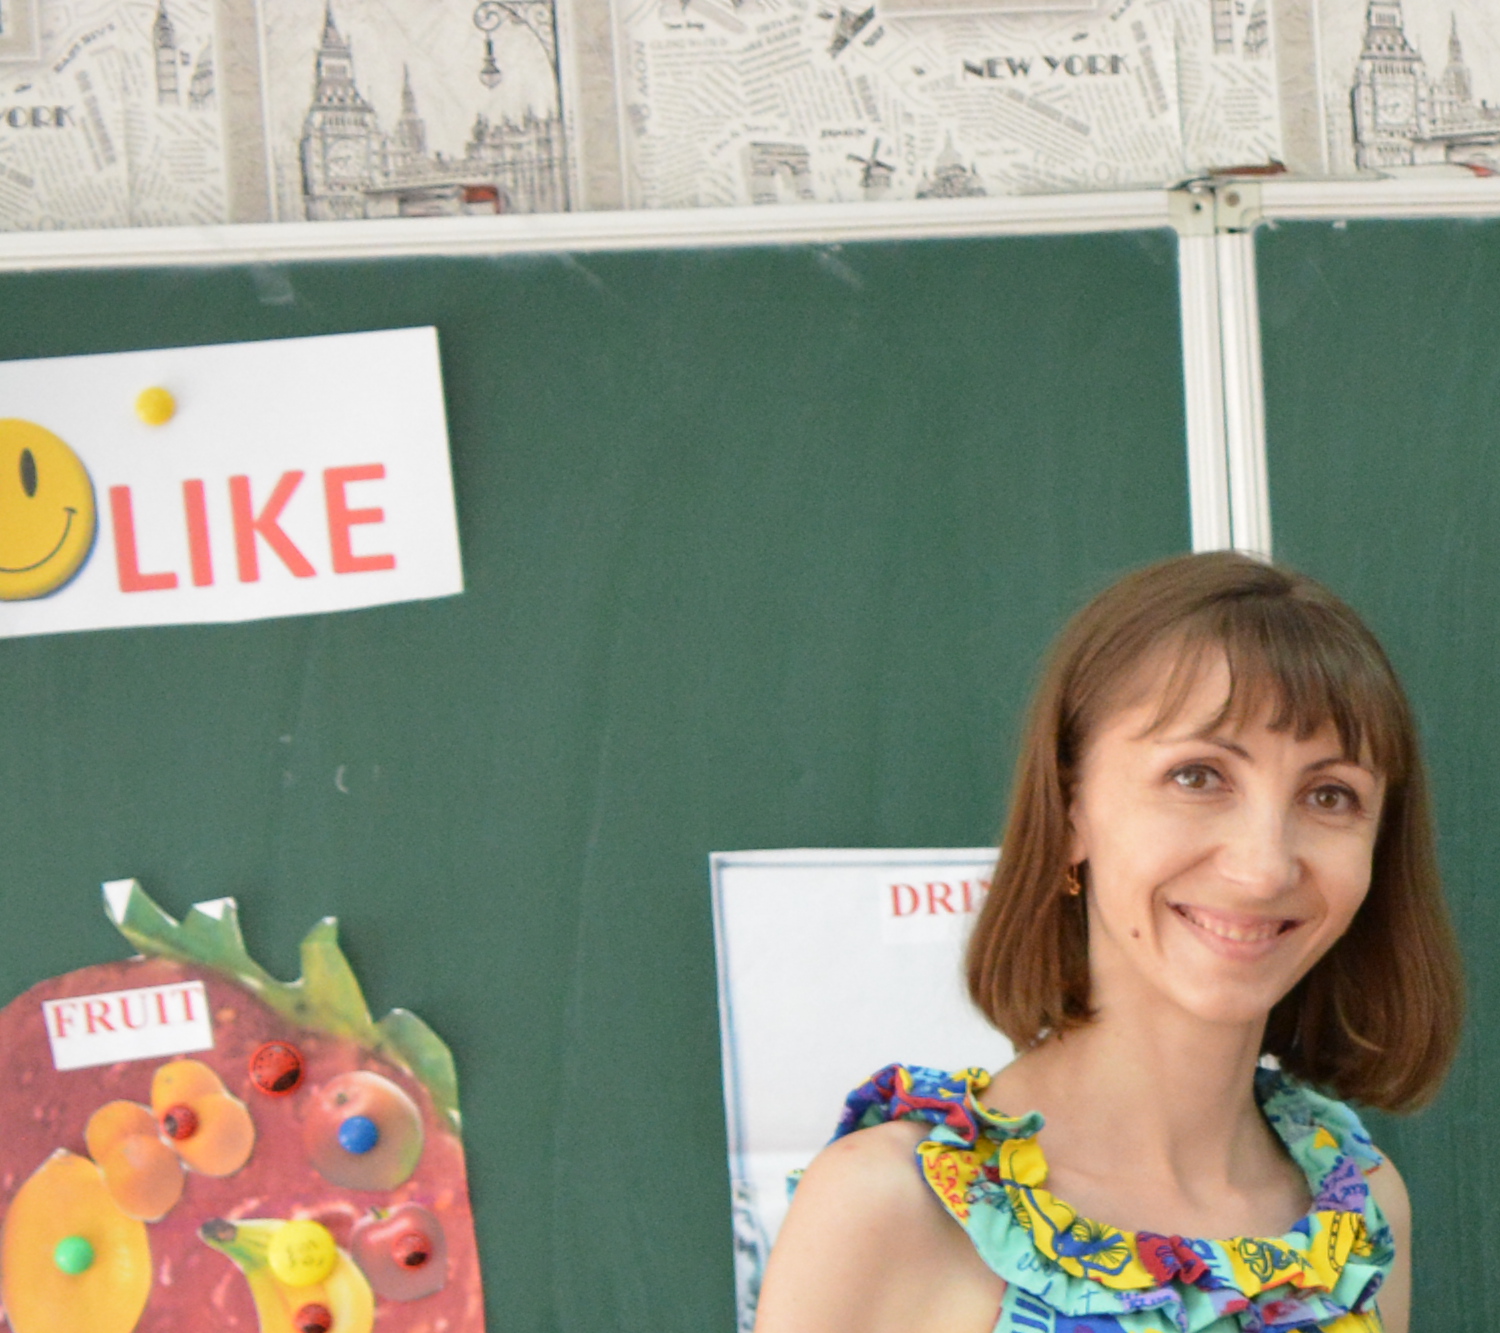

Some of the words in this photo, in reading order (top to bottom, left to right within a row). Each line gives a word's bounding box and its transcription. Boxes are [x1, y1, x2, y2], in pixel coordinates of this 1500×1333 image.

[961, 56, 1036, 80] NEW
[1044, 53, 1132, 77] YORK
[0, 104, 77, 129] ORK
[109, 462, 397, 593] LIKE
[52, 984, 203, 1041] FRUIT
